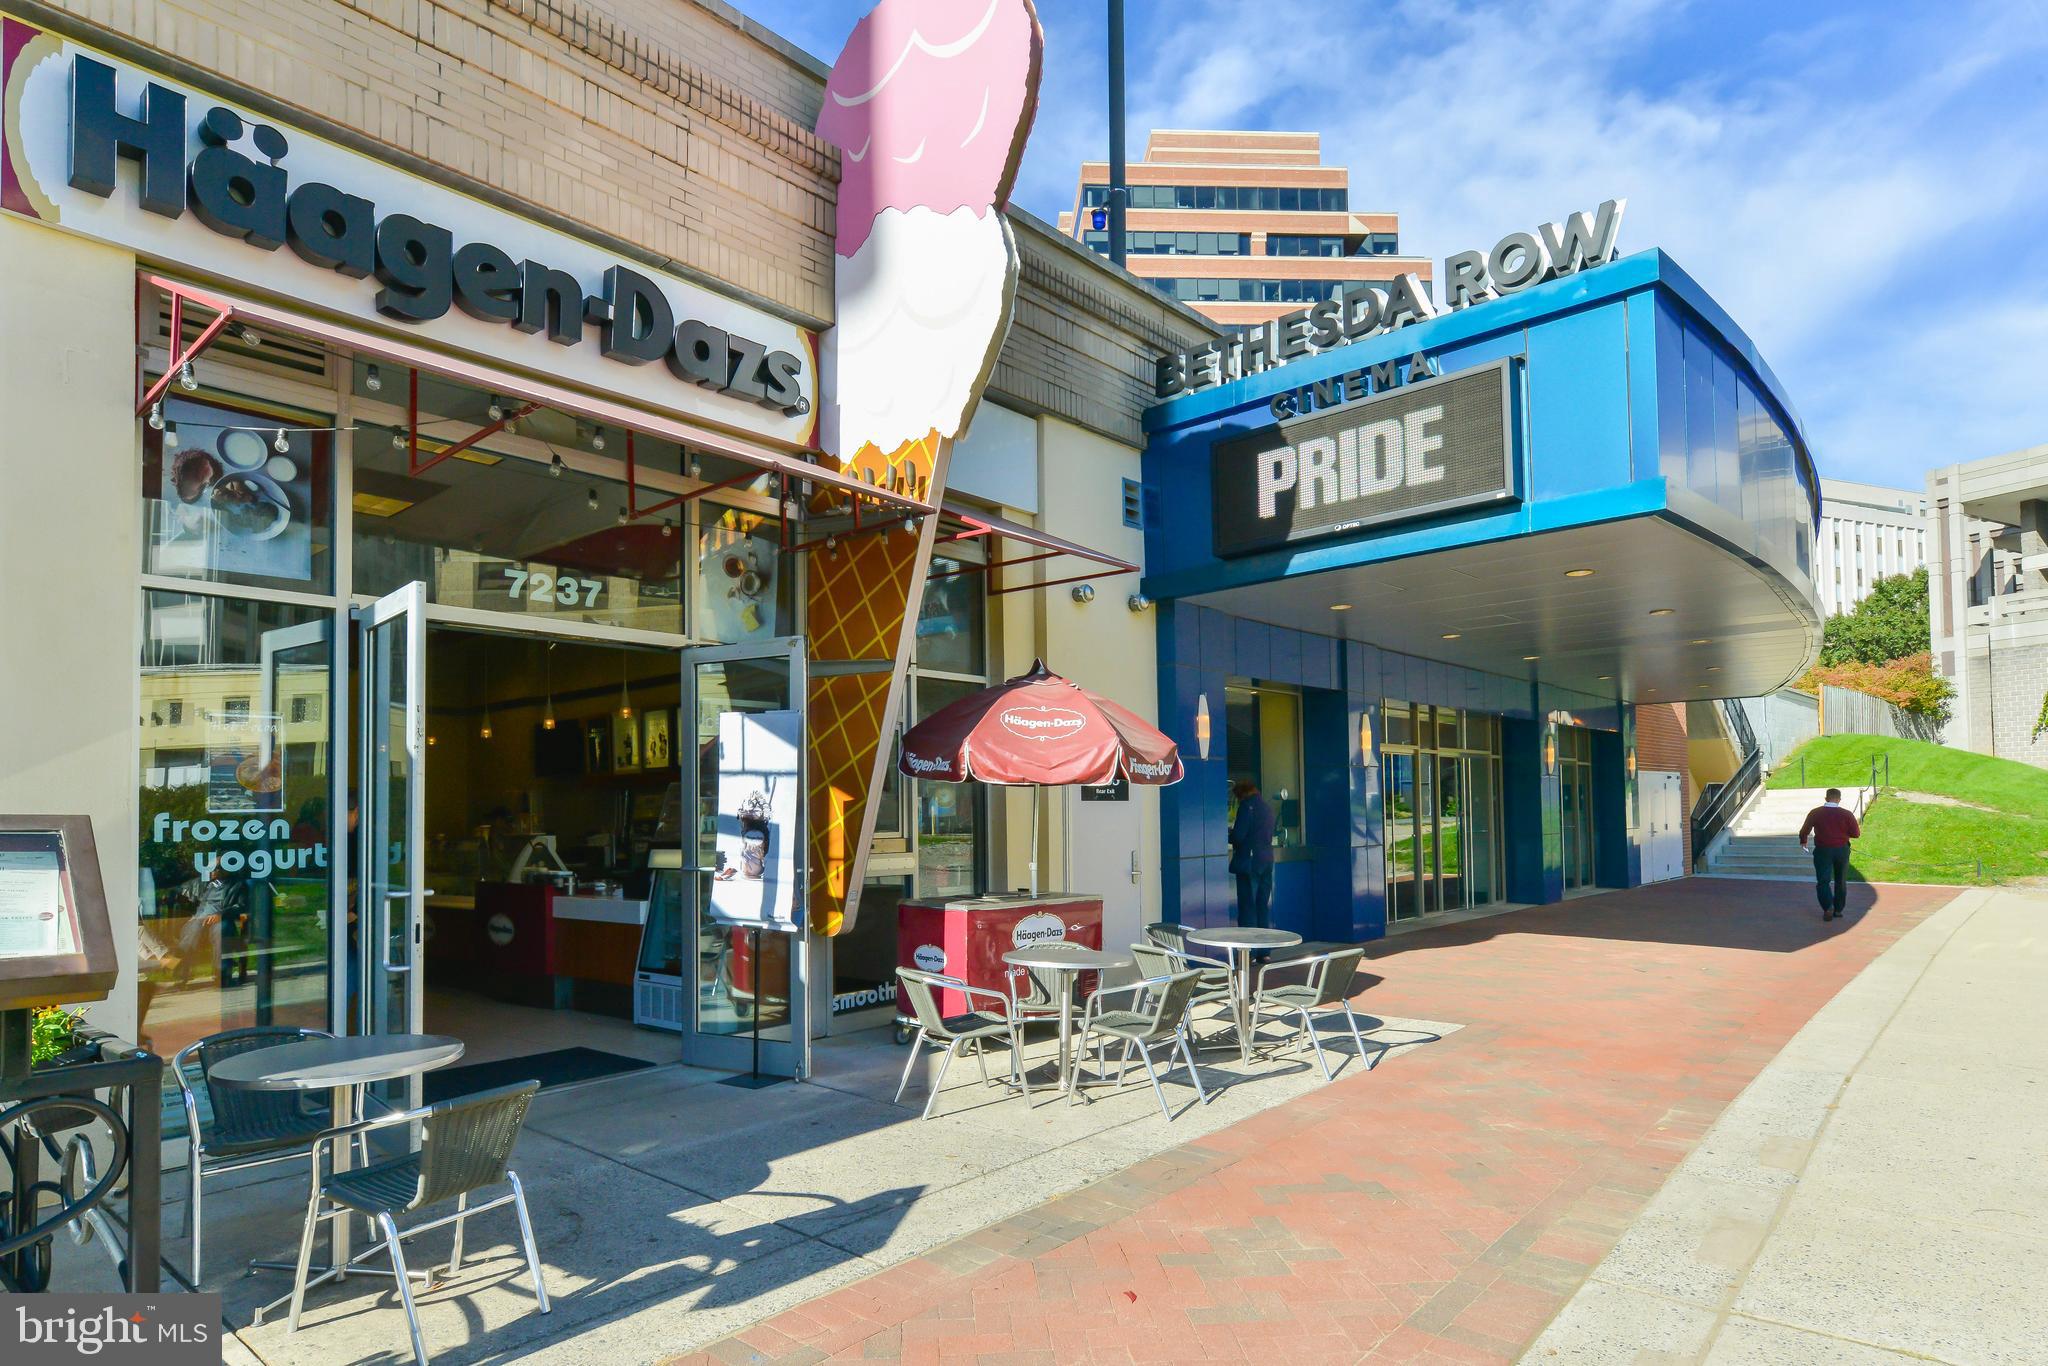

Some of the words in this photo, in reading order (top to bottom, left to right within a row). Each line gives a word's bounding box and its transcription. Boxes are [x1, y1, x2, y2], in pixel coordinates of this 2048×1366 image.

[67, 53, 803, 412] Häagen-Dazs
[1155, 272, 1437, 399] BETHESDA
[1445, 198, 1628, 312] ROW
[1270, 351, 1436, 421] CINEMA
[1257, 404, 1446, 520] PRIDE
[504, 568, 603, 608] 7237
[153, 812, 290, 843] frozen
[194, 843, 328, 882] yogurt
[1016, 926, 1063, 943] Häagen-Dazs
